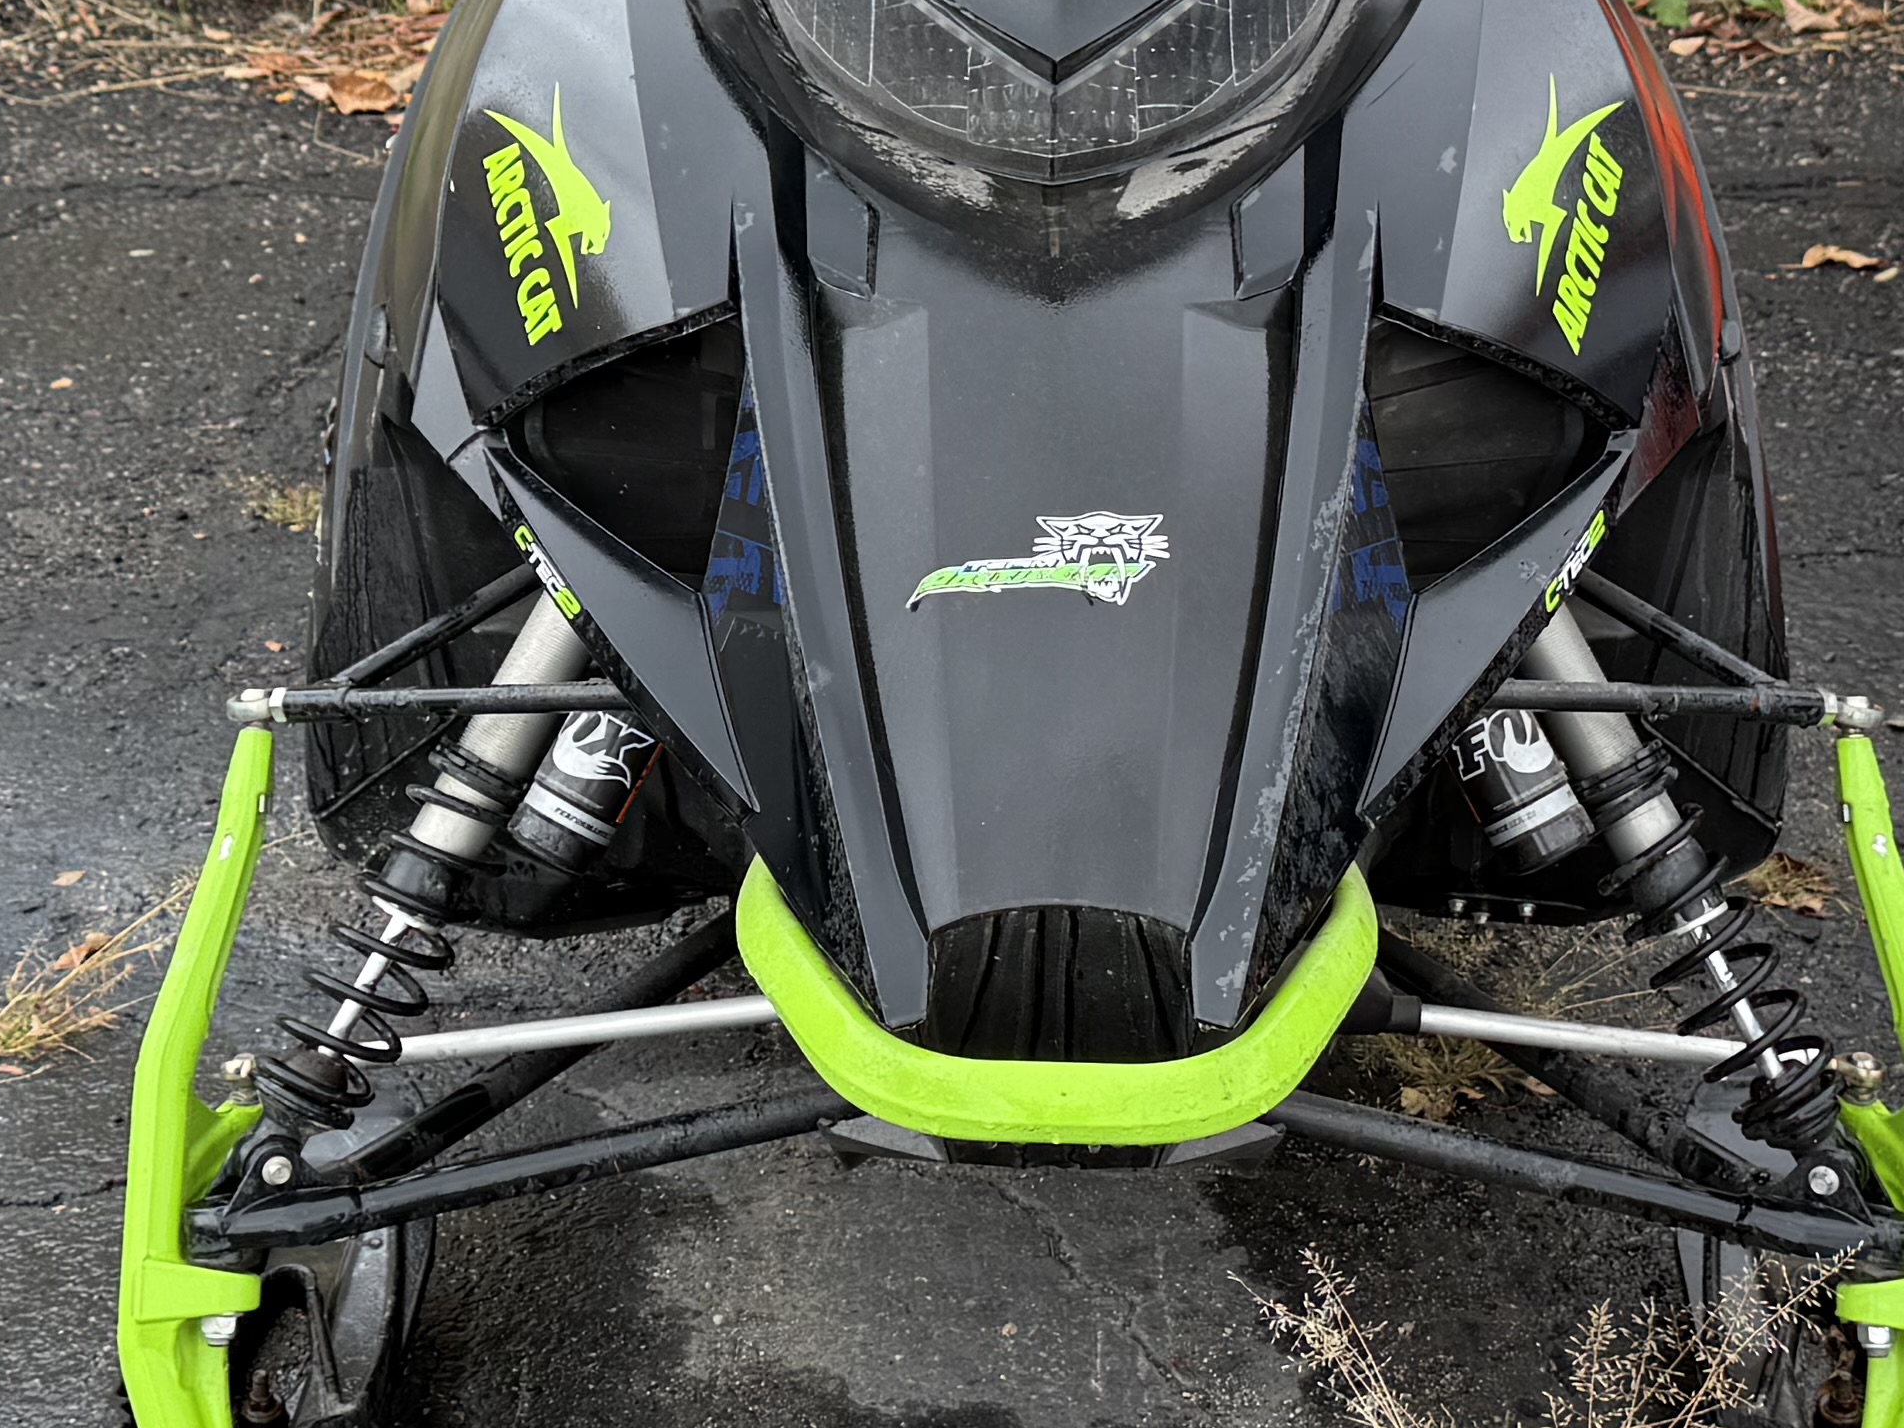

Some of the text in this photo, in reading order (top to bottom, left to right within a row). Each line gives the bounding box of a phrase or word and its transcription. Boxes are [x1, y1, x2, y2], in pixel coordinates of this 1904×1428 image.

[482, 142, 563, 346] ARCTIC CAT
[1552, 131, 1624, 356] ARCTIC CAT
[514, 524, 582, 620] C-TEC2
[1545, 509, 1606, 613] C-TEC2
